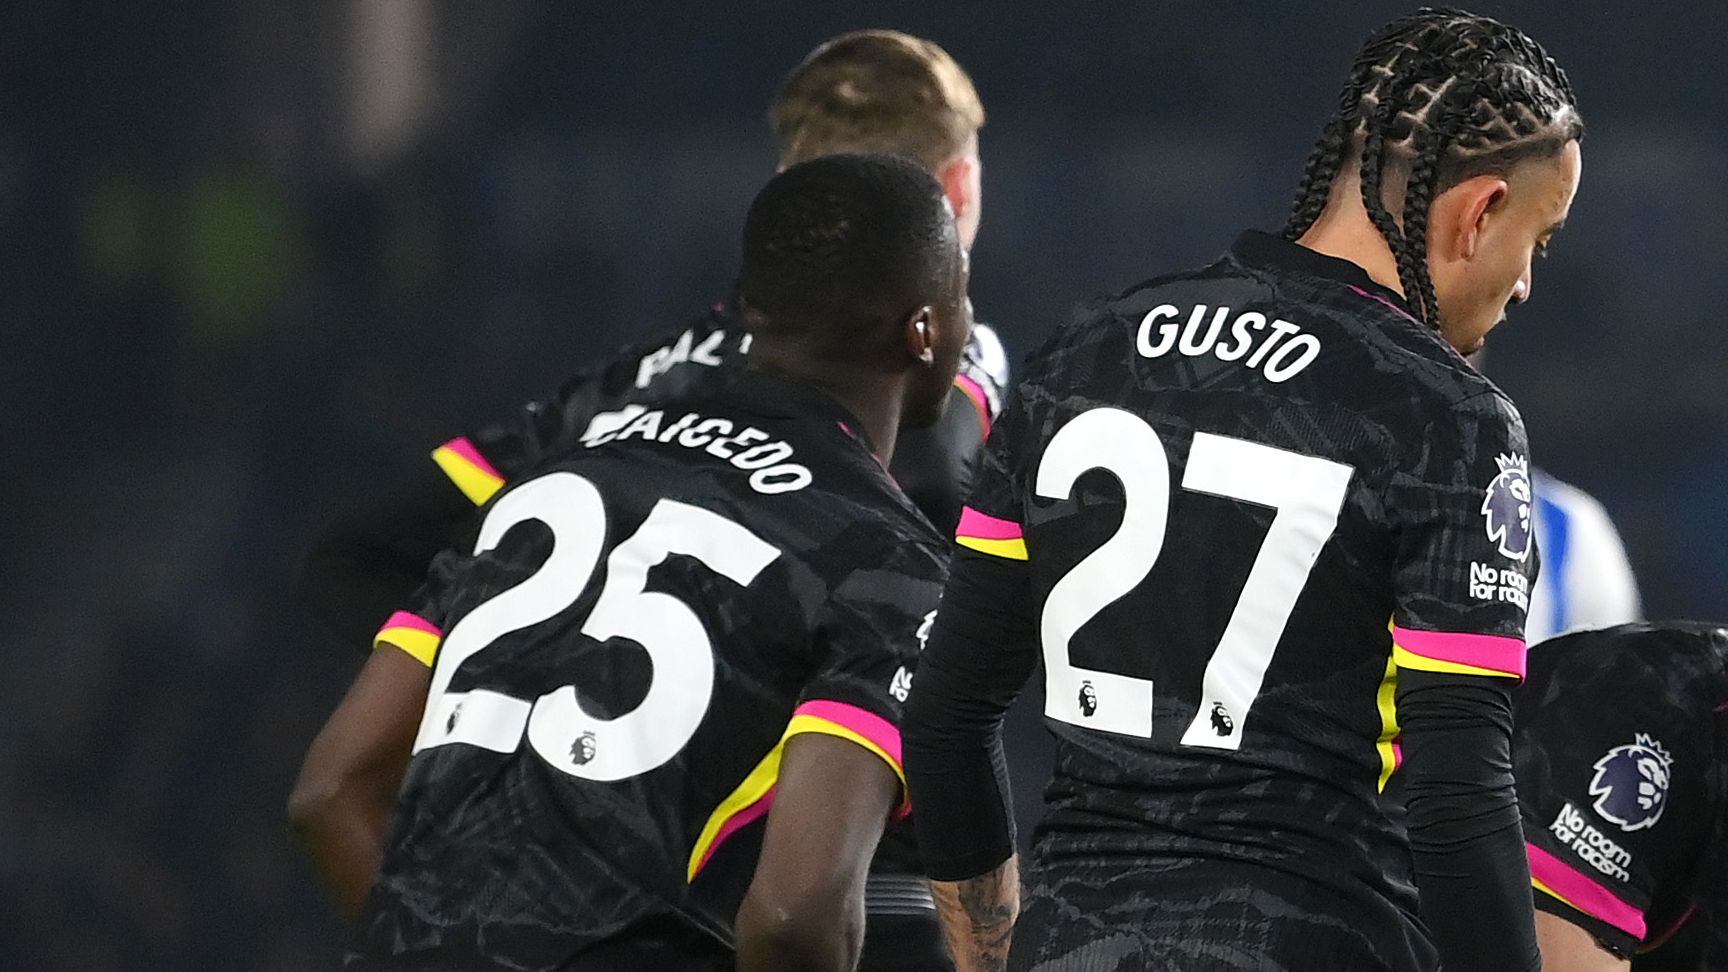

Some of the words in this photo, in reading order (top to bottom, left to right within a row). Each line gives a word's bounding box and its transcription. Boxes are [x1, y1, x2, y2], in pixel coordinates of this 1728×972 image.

[1136, 304, 1321, 383] GUSTO
[1036, 407, 1356, 751] 27
[1469, 561, 1498, 584] No
[1469, 579, 1497, 601] for
[411, 472, 782, 782] 25
[1549, 819, 1578, 844] for
[1571, 838, 1630, 882] racism
[1556, 803, 1585, 832] No
[1581, 825, 1632, 868] room
